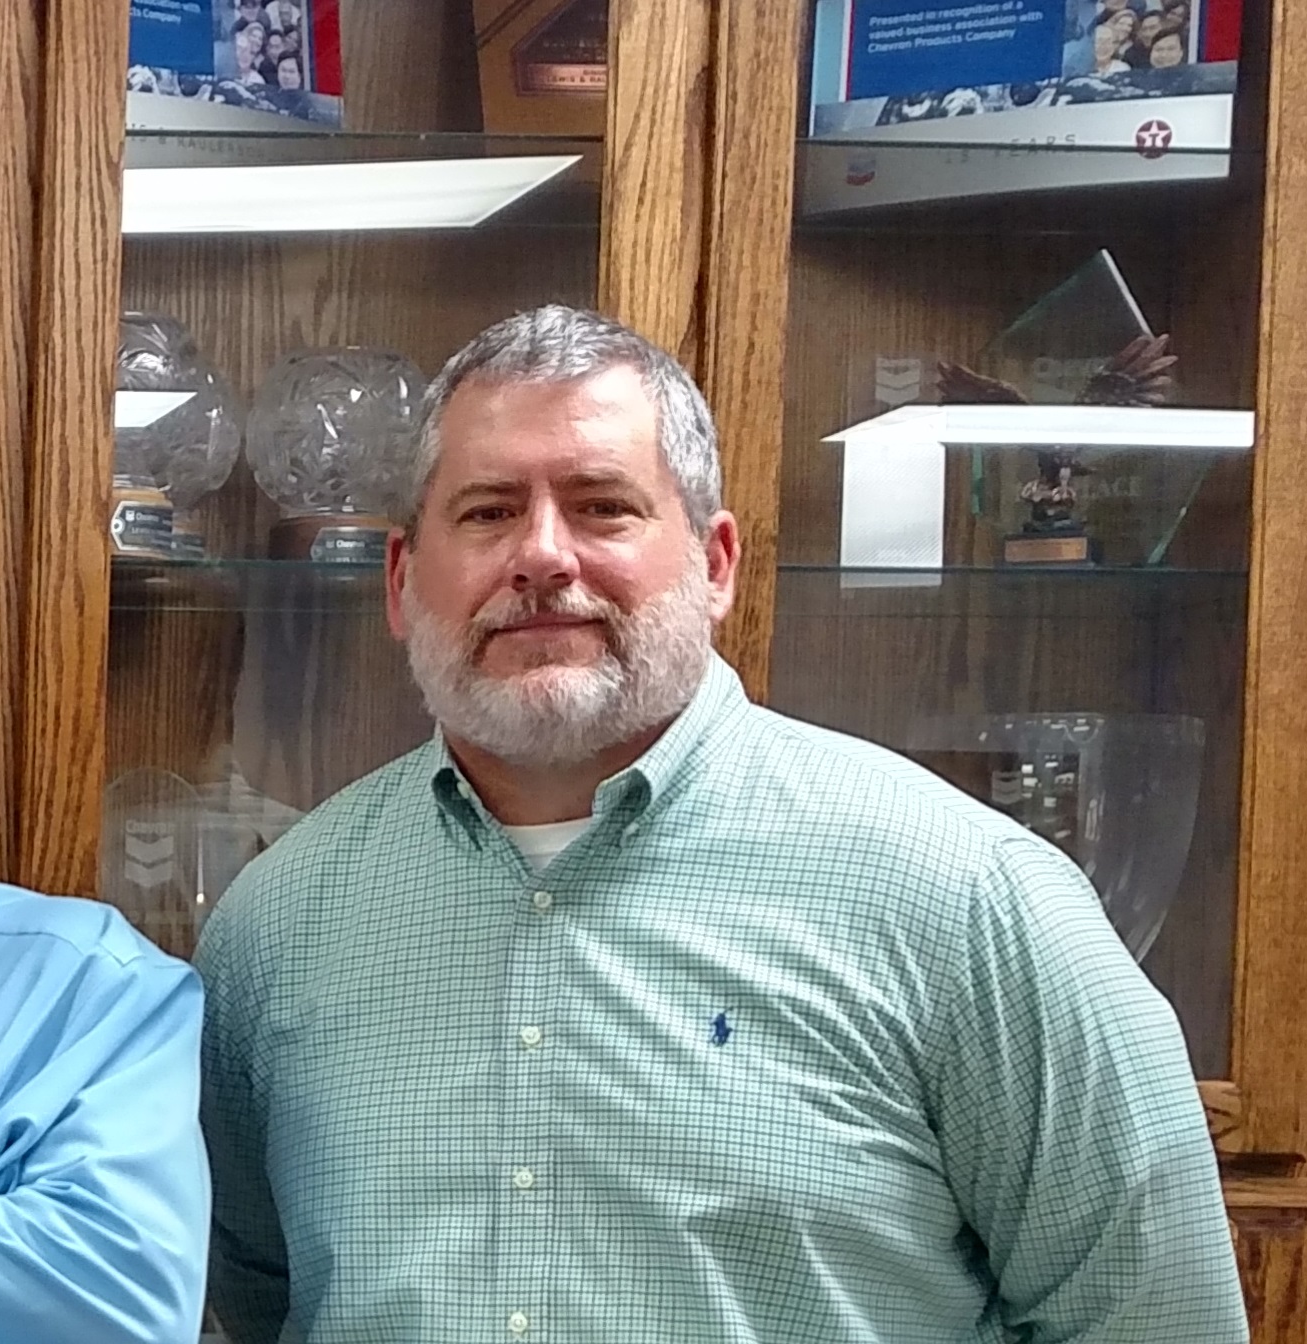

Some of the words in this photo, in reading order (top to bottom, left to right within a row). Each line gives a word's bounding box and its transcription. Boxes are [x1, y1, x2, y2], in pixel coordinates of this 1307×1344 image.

[869, 10, 923, 27] Presented
[938, 2, 1000, 20] recognition
[906, 23, 953, 37] business
[955, 14, 1017, 32] association
[868, 40, 913, 54] Chevron
[914, 34, 963, 49] Products
[965, 28, 1017, 43] Company
